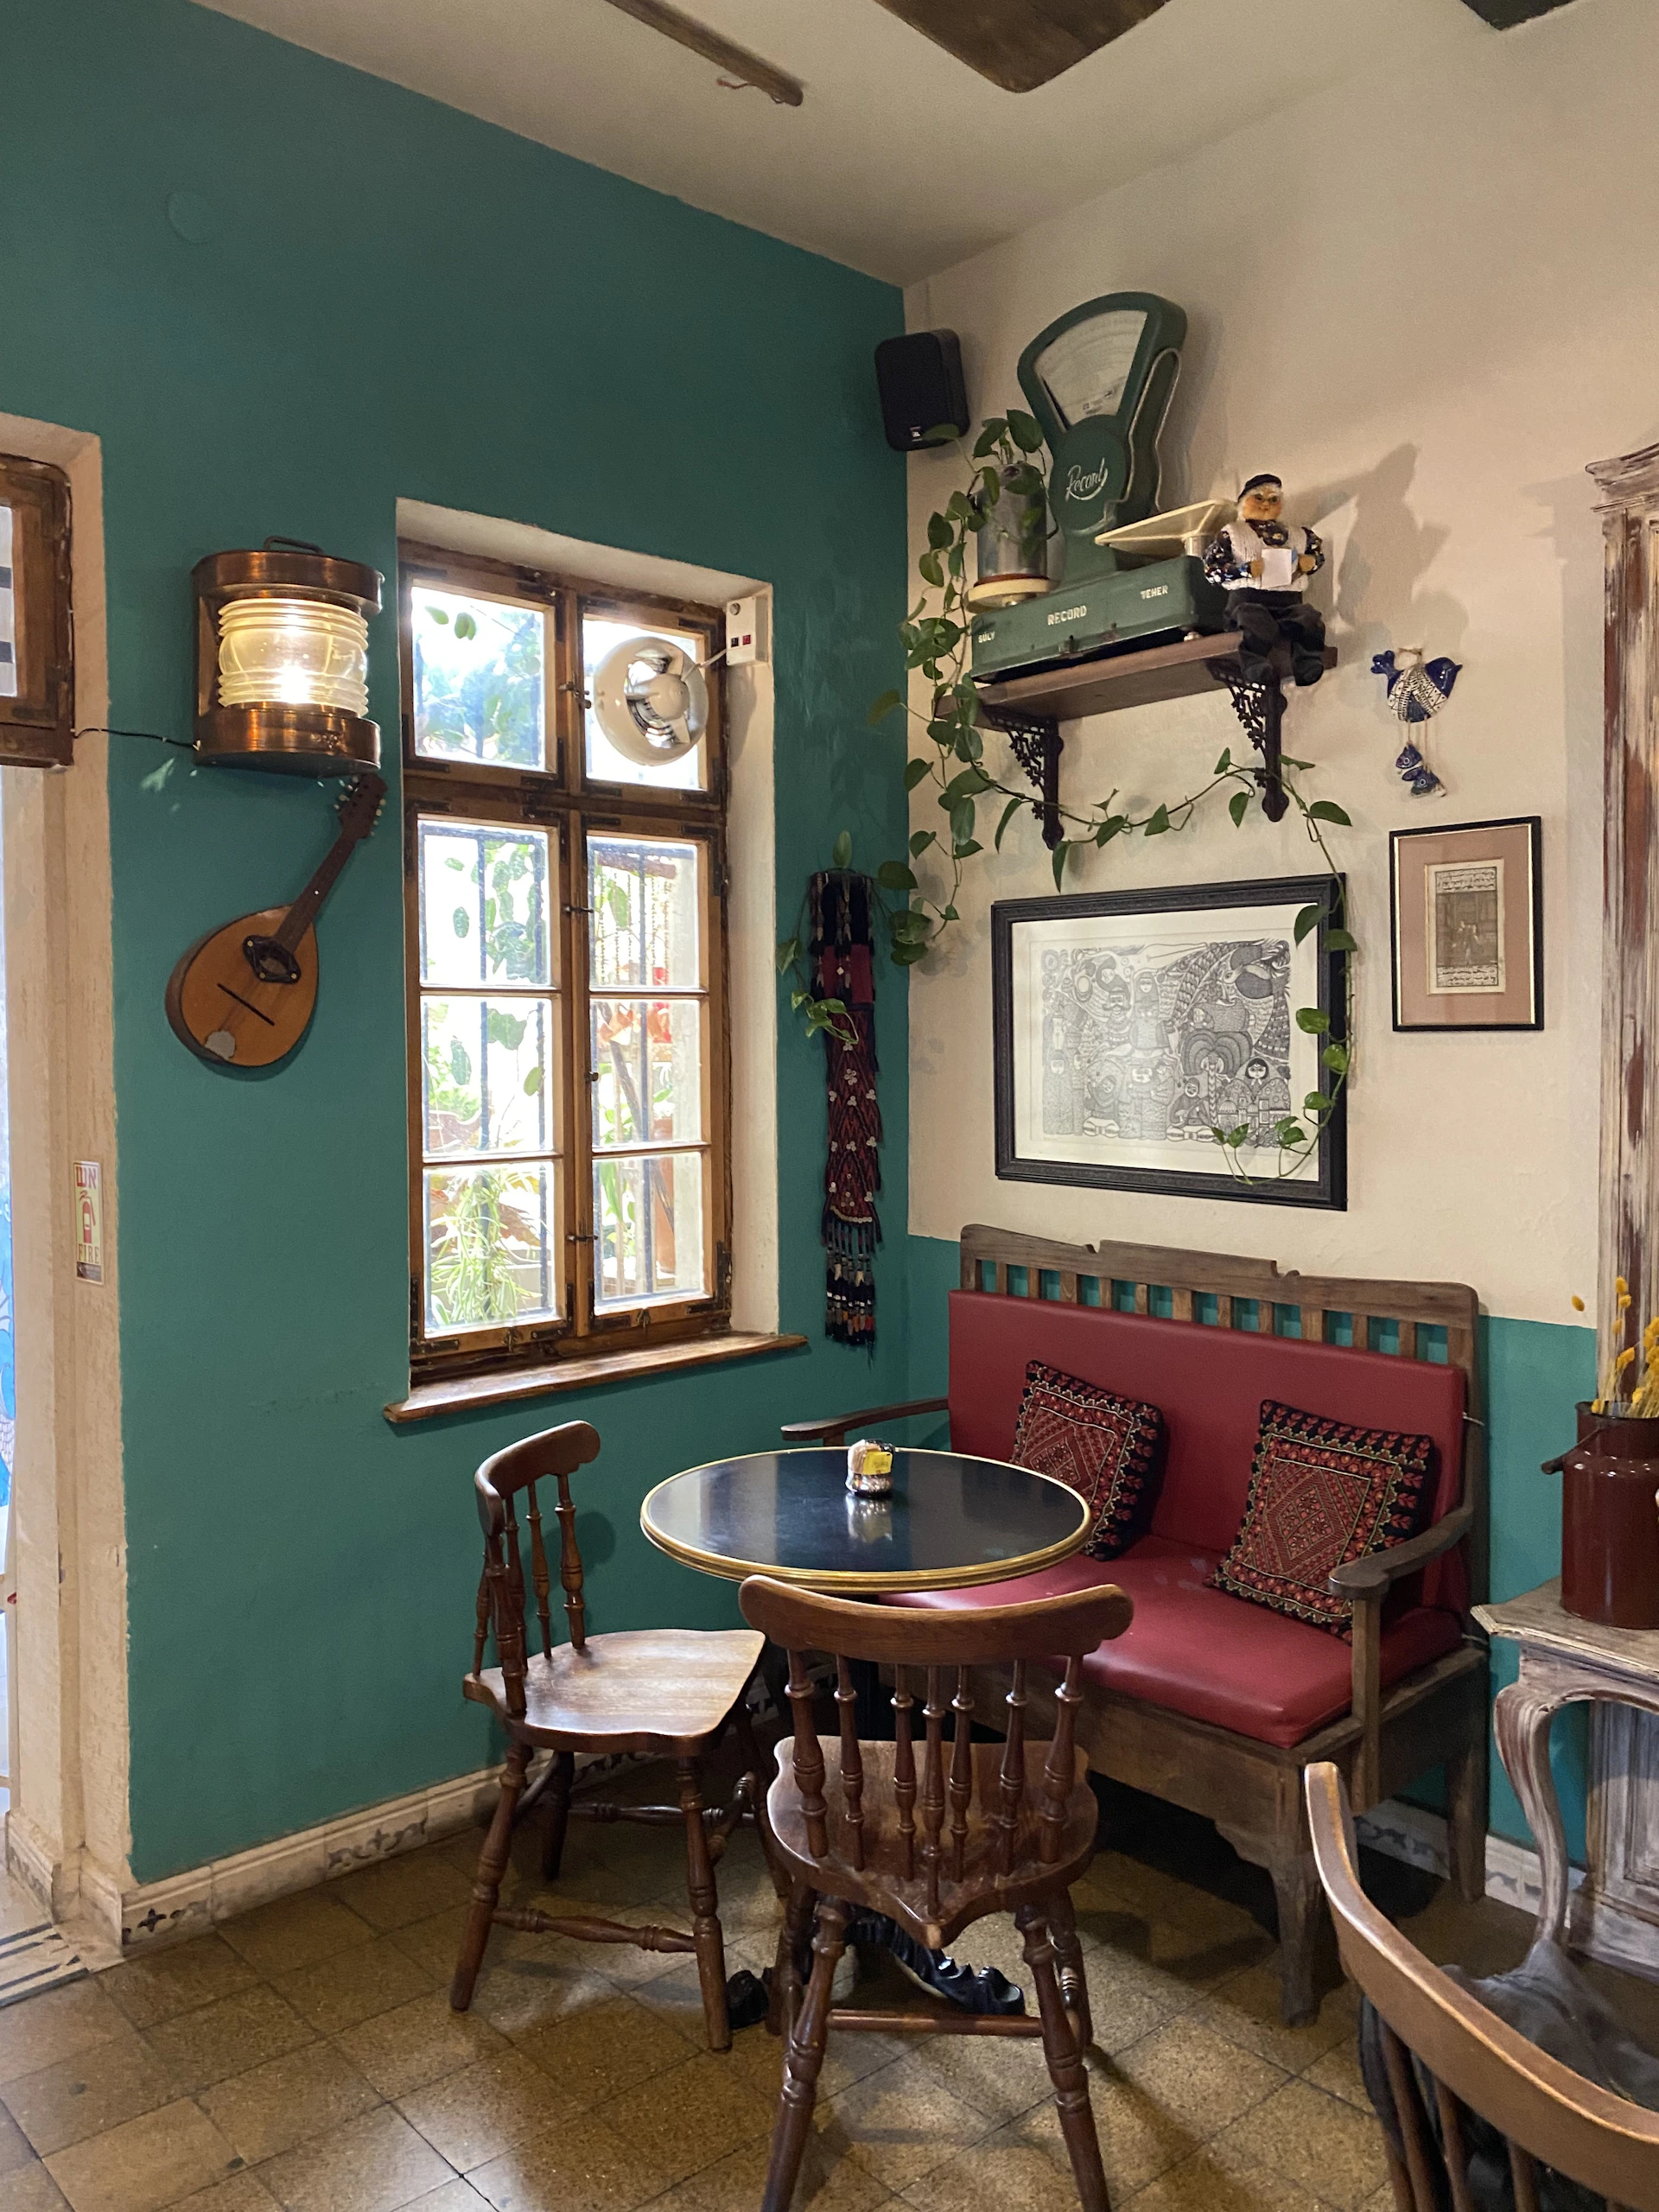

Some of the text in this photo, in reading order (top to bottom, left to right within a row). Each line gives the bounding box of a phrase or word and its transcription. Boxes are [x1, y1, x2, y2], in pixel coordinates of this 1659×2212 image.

[1065, 457, 1109, 501] Record
[1047, 605, 1088, 626] RECORD
[1140, 584, 1168, 600] TEHER
[75, 1166, 97, 1189] אש
[78, 1243, 100, 1264] FIRE
